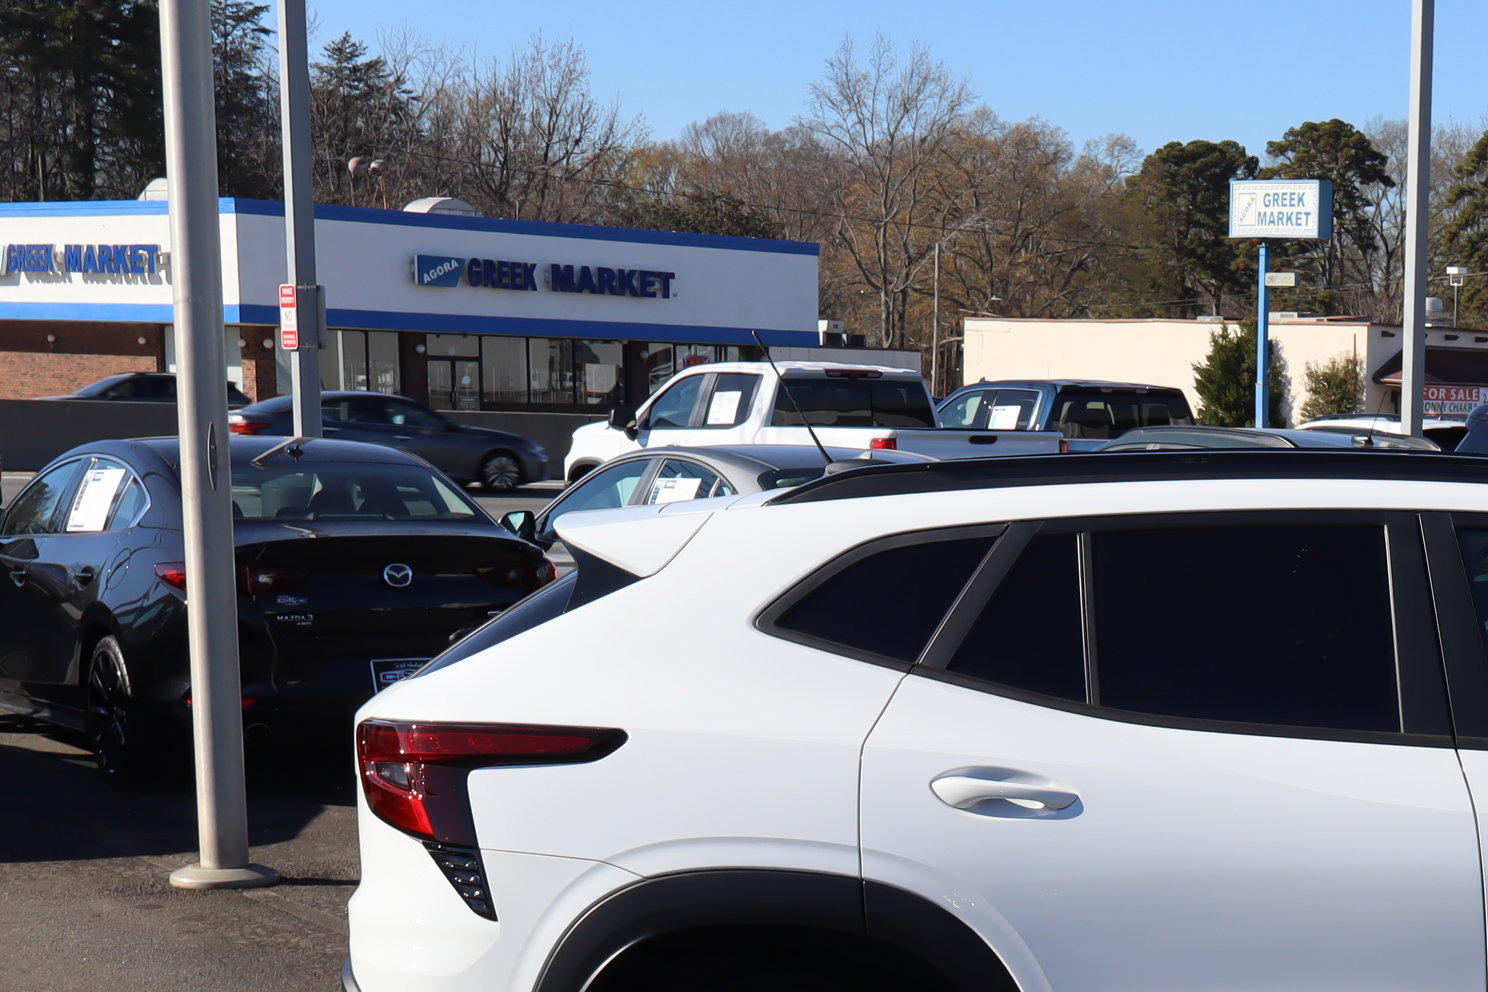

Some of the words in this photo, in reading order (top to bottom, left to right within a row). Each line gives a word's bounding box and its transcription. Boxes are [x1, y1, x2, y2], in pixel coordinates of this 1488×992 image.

[1263, 192, 1306, 208] GREEK
[1257, 211, 1312, 227] MARKET
[7, 243, 55, 273] GREEK
[64, 243, 159, 274] MARKET
[423, 259, 459, 285] AGORA
[467, 257, 538, 292] GREEK
[549, 263, 676, 299] MARKET
[1450, 388, 1479, 401] SALE
